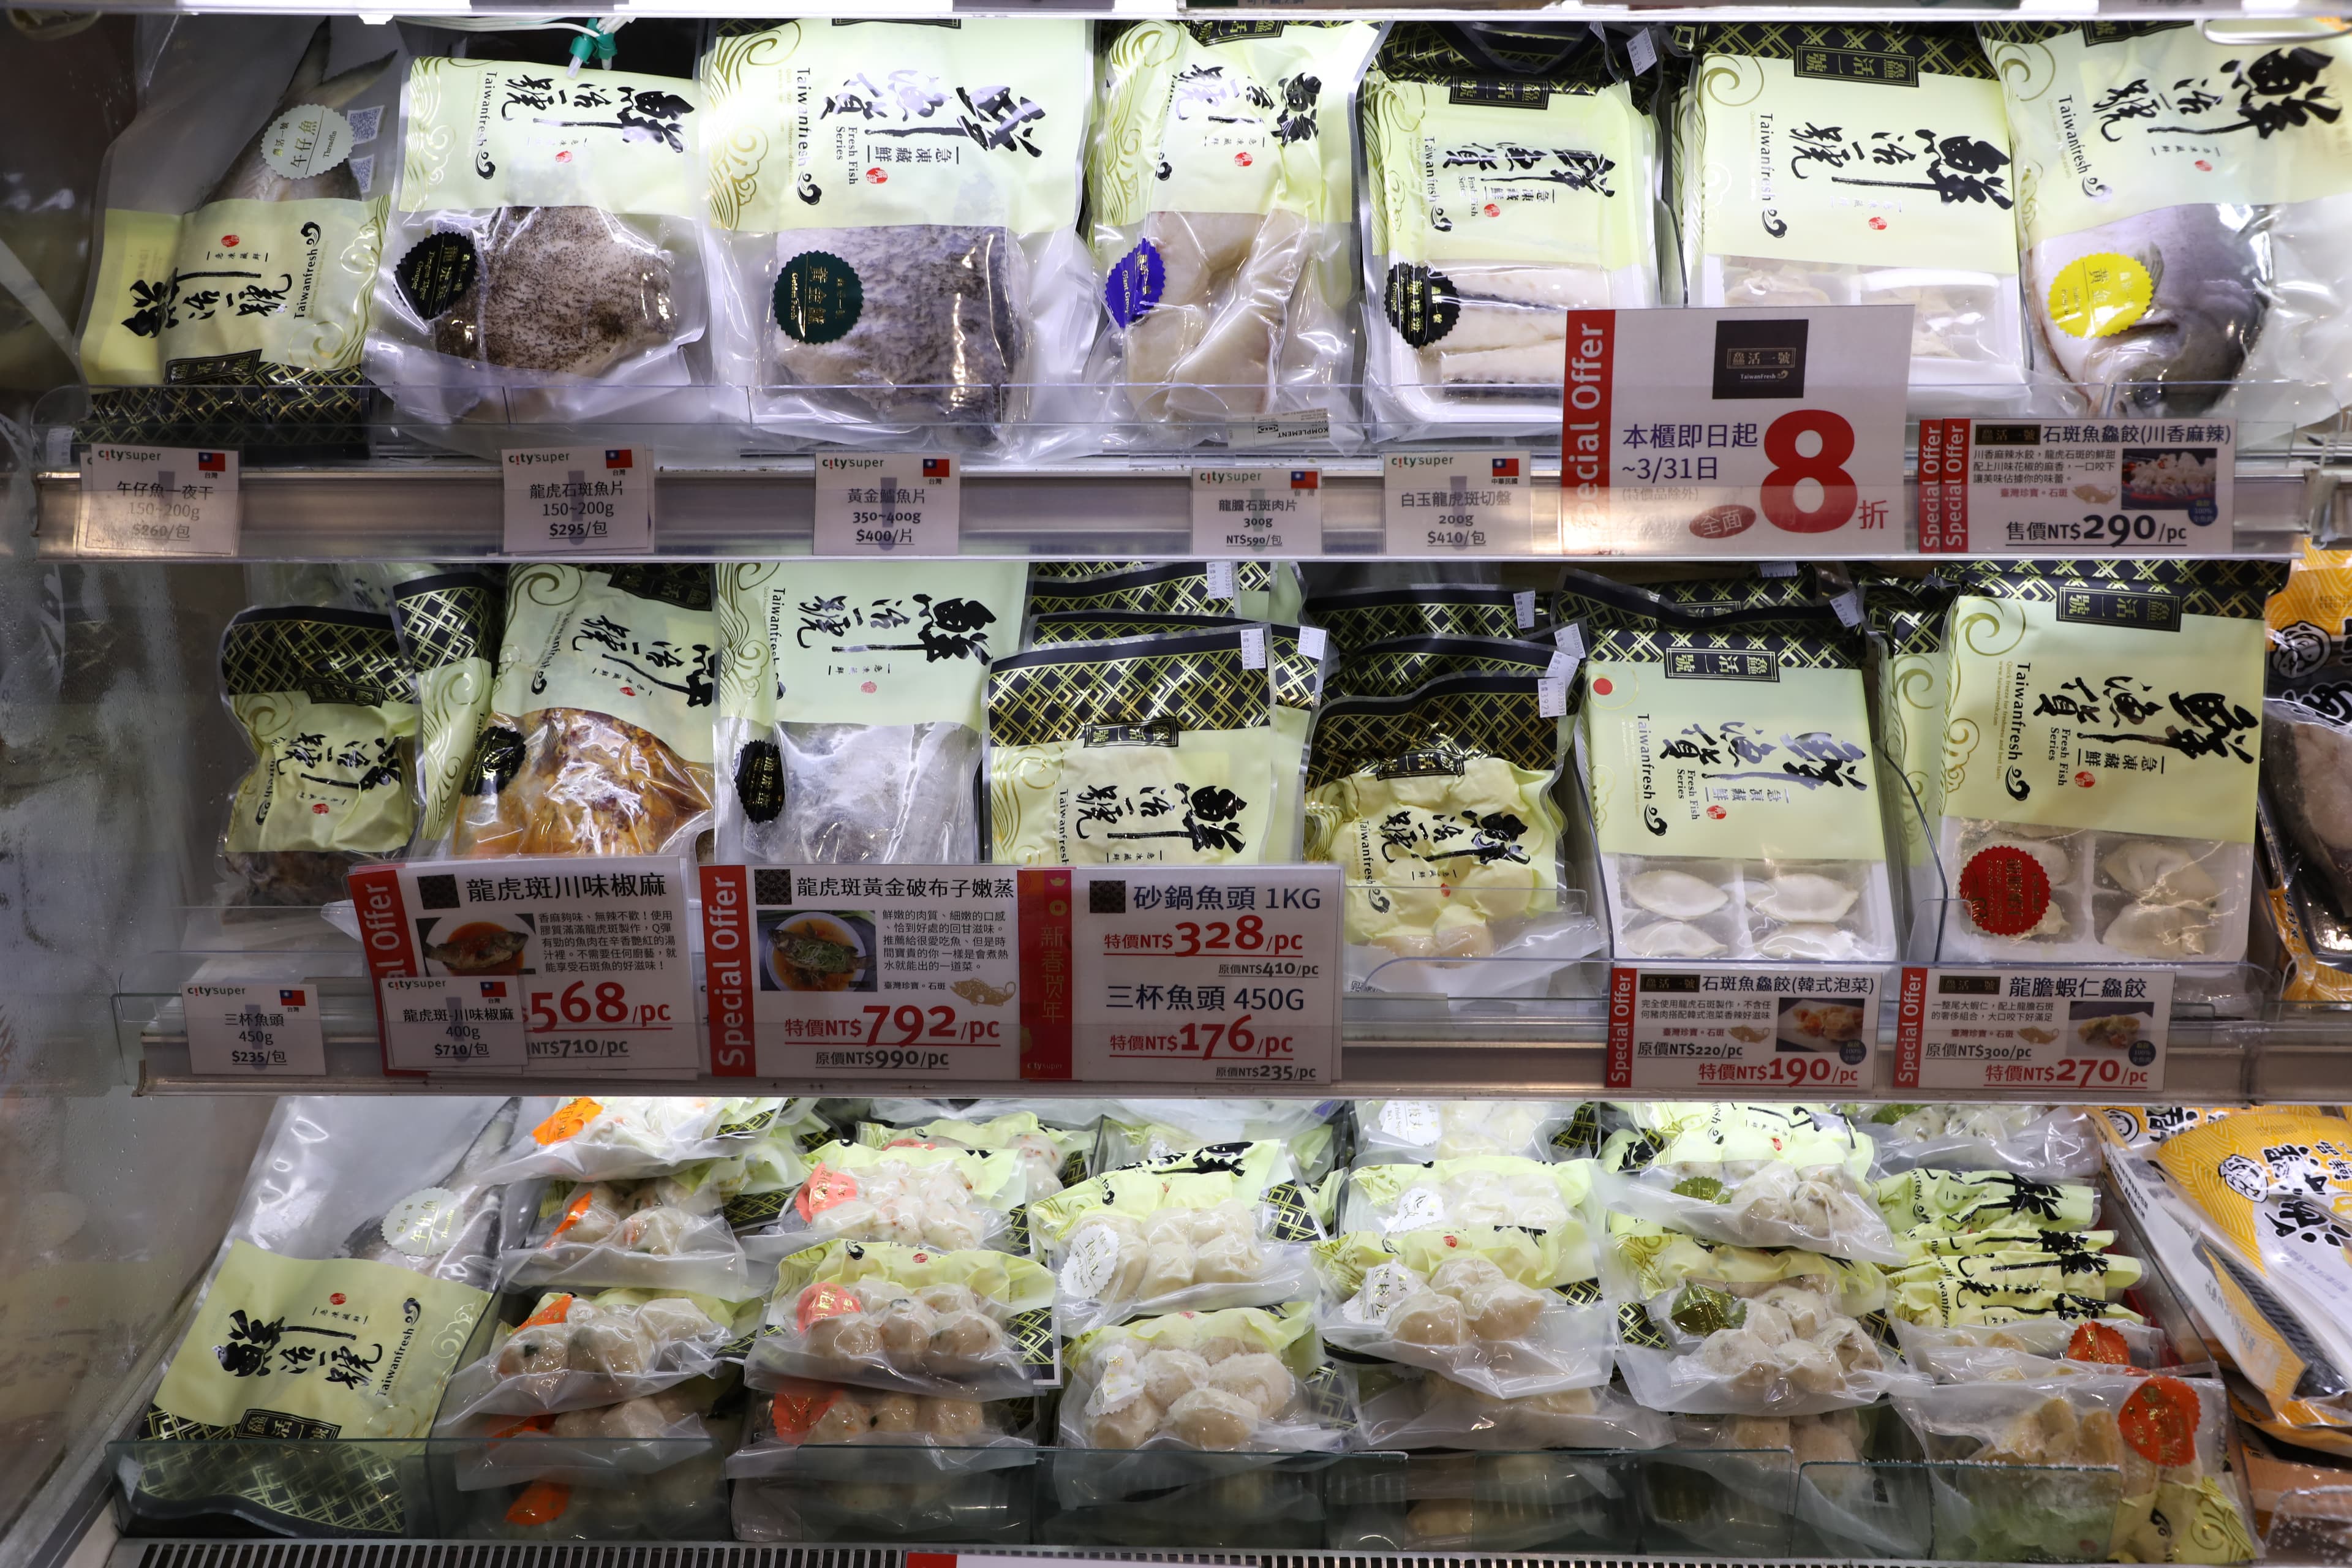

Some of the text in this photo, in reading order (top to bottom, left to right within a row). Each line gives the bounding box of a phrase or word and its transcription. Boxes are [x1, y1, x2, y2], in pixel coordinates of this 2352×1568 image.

[477, 72, 498, 146] Taiwanfresh
[796, 67, 810, 167] Taiwanfresh
[290, 119, 317, 168] 午仔魚
[323, 131, 337, 159] Threadfin
[2058, 94, 2089, 175] Taiwanfresh
[848, 127, 858, 186] Fresh Fish
[875, 146, 954, 164] 急凍藏鮮
[1760, 113, 1776, 202] Taiwanfresh
[1425, 136, 1441, 203] Taiwanfresh
[1491, 188, 1548, 203] 急凍藏鮮
[294, 247, 318, 319] Taiwanfresh
[411, 261, 424, 290] Grouper
[790, 272, 799, 320] Golden Perch
[808, 265, 828, 324] 黃金鱸
[1570, 323, 1604, 410] Offer
[1278, 426, 1329, 439] KOMPLEMENT
[1623, 422, 1758, 449] 本櫃即日起
[1622, 456, 1717, 483] ~3/31日
[117, 480, 214, 500] 午仔魚一夜干
[529, 480, 623, 499] 龍虎石斑魚片
[847, 488, 925, 504] 黃金鱸魚片
[1401, 491, 1512, 508] 白玉龍虎斑切盤
[1923, 426, 1940, 547] Special Offer
[1945, 426, 1964, 546] Special Offer
[128, 502, 200, 521] 150~200g
[543, 501, 614, 517] 150~200g
[853, 512, 922, 524] 350~400g
[1219, 499, 1297, 511] 龍膽石斑肉片
[549, 521, 608, 537] $295/包
[1243, 518, 1273, 528] 300g
[1439, 514, 1474, 526] 200g
[1700, 508, 1743, 535] 全面
[856, 529, 912, 543] $400/片
[1226, 534, 1283, 546] NT$590/包
[1427, 530, 1487, 545] $410/包
[2003, 680, 2012, 699] freeze
[1999, 710, 2010, 738] freshness
[2008, 662, 2031, 760] Taiwanfresh
[1637, 714, 1656, 800] Taiwanfresh
[2049, 727, 2060, 760] Series
[2058, 728, 2071, 786] Fresh Fish
[1997, 752, 2005, 764] best
[2085, 750, 2158, 773] 急凍藏鮮
[1687, 770, 1698, 820] Fresh Fish
[1713, 788, 1782, 803] 急凍藏鮮
[1358, 820, 1374, 886] Taiwanfresh
[466, 872, 667, 902] 龍虎斑川味椒麻
[796, 876, 1015, 900] 龍虎斑黃金破布子嫩蒸
[1133, 884, 1321, 911] 砂鍋魚頭 1KG
[365, 883, 392, 951] Offer
[883, 910, 1006, 922] 鮮嫩的肉質、細嫩的口感
[883, 935, 1006, 947] 推薦給很愛吃魚、但是時
[1104, 914, 1303, 957] 特價NT$328/pc
[545, 961, 664, 973] 能享受石斑魚的好滋味！
[708, 876, 745, 1068] Special Offer
[884, 960, 981, 972] 水就能出的一道菜。
[1218, 962, 1319, 976] 原價NT$410/pc
[1106, 984, 1305, 1011] 三杯魚頭 450G
[2009, 977, 2147, 998] 龍膽蝦仁鱻餃
[225, 1012, 285, 1027] 三杯魚頭
[402, 1007, 514, 1022] 龍虎斑-川味椒麻
[785, 1005, 1000, 1048] 特價NT$792/pc
[1611, 974, 1631, 1082] Special Offer
[239, 1030, 274, 1046] 450g
[446, 1025, 481, 1040] 400g
[1109, 1014, 1294, 1061] 特價NT$176/pc
[1899, 974, 1922, 1083] Special Offer
[232, 1050, 287, 1064] $235/包
[434, 1042, 489, 1057] $710/包
[816, 1051, 949, 1069] 原價NT$990/pc
[1637, 1042, 1743, 1058] 原價NT$220/pc
[1926, 1042, 2032, 1059] 原價NT$300/pc
[1215, 1065, 1316, 1080] 原價NT$235/pc
[1698, 1058, 1858, 1088] 特價NT$190/pc
[1985, 1059, 2148, 1089] 特價NT$270/pc
[440, 1208, 455, 1239] Threadfin
[375, 1326, 415, 1397] Taiwanfresh
